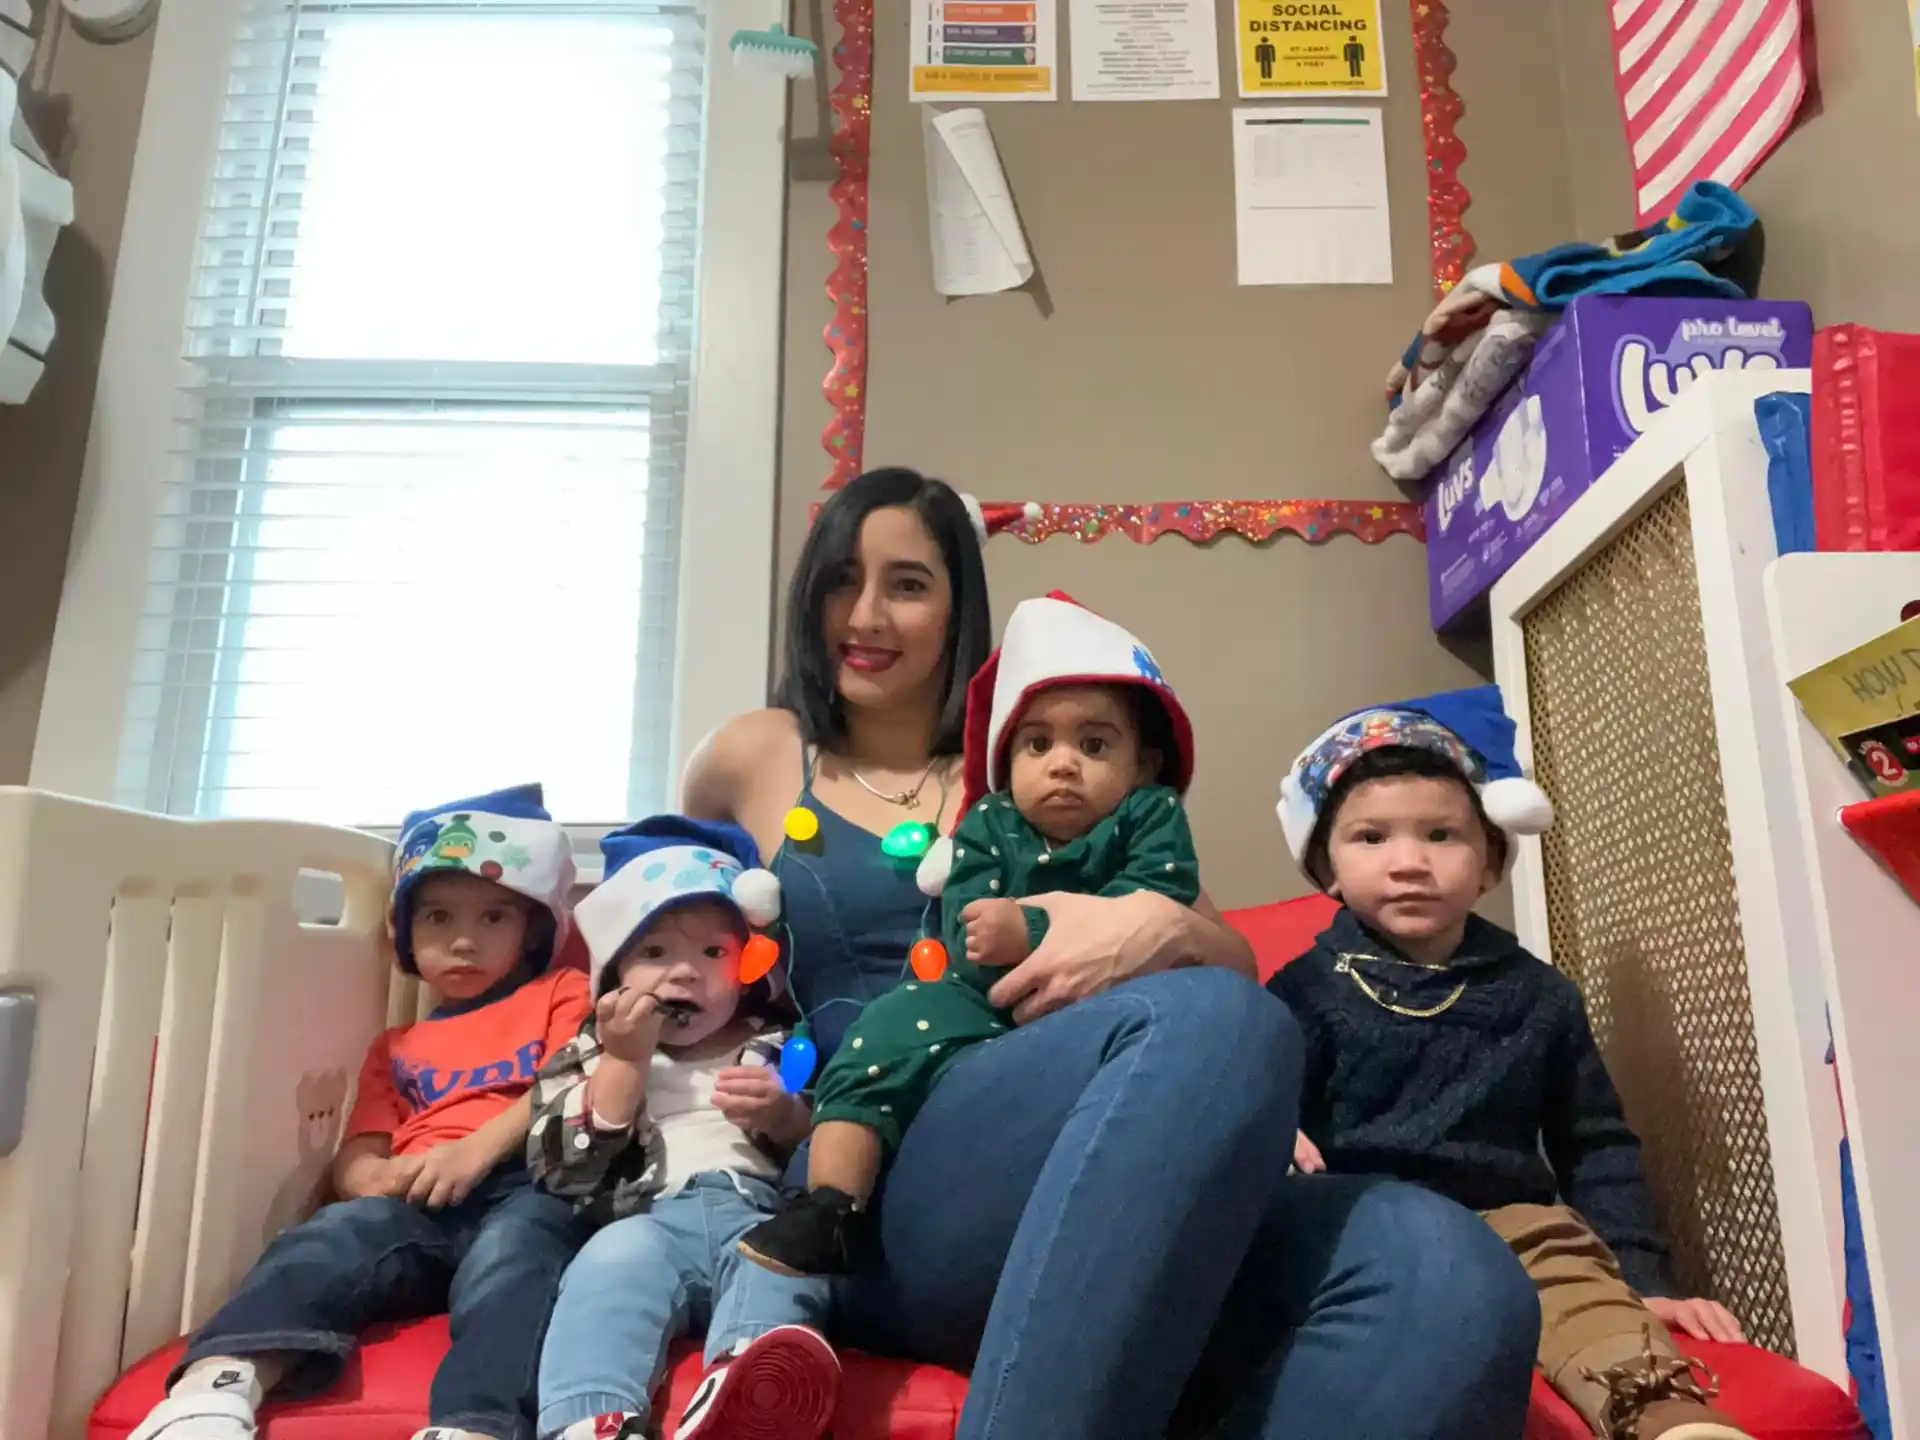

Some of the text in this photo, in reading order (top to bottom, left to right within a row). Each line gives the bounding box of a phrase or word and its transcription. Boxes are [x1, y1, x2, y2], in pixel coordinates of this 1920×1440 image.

[1272, 4, 1342, 17] SOCIAL
[1249, 19, 1367, 32] DISTANCING
[1681, 315, 1786, 341] pro level
[1843, 655, 1906, 703] HOW
[1871, 750, 1899, 776] 2
